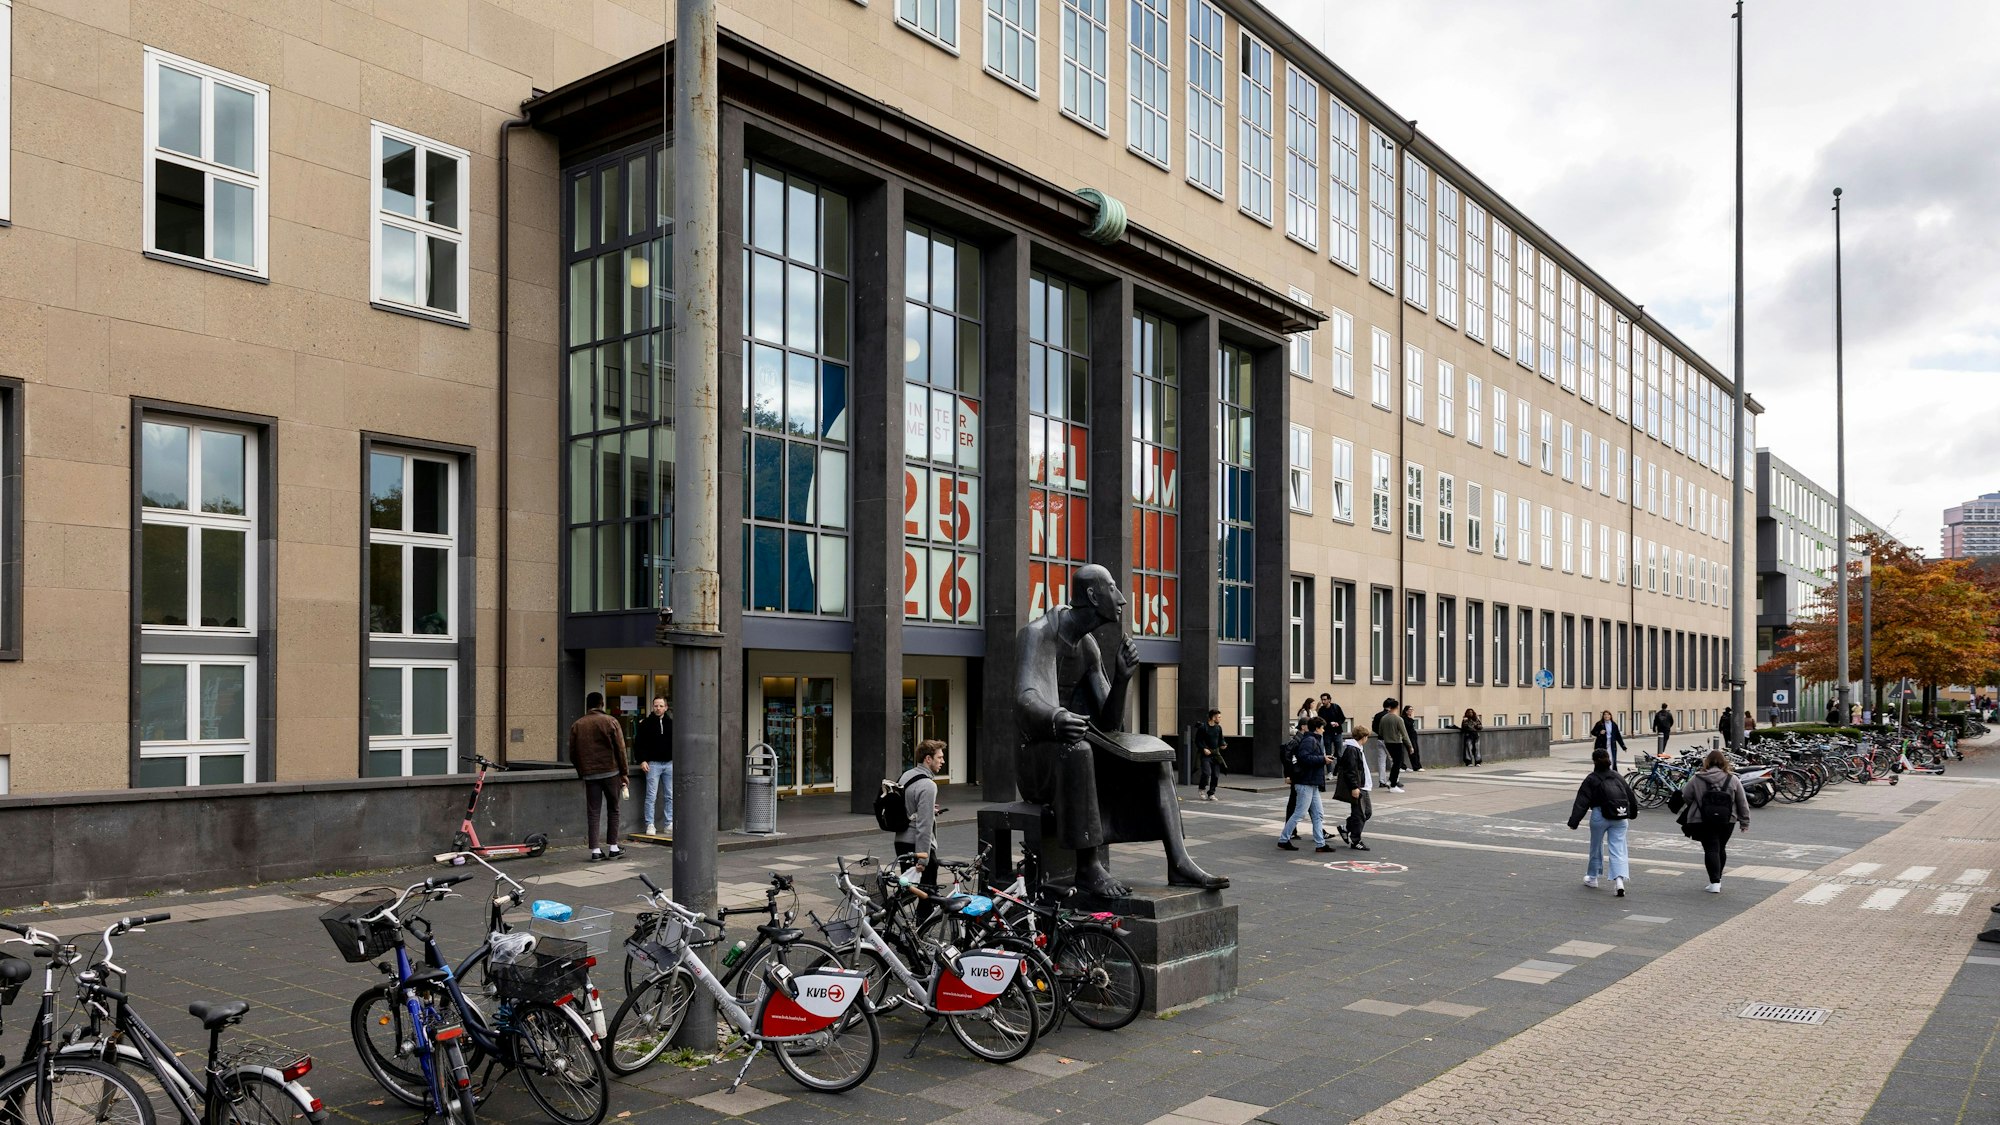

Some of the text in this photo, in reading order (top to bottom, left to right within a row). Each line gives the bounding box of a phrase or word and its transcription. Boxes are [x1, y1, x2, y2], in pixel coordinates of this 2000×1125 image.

[908, 401, 967, 428] INTER
[906, 420, 974, 447] MESTER
[971, 967, 989, 977] KVB
[704, 979, 738, 1018] nextbike
[806, 987, 827, 998] KVB
